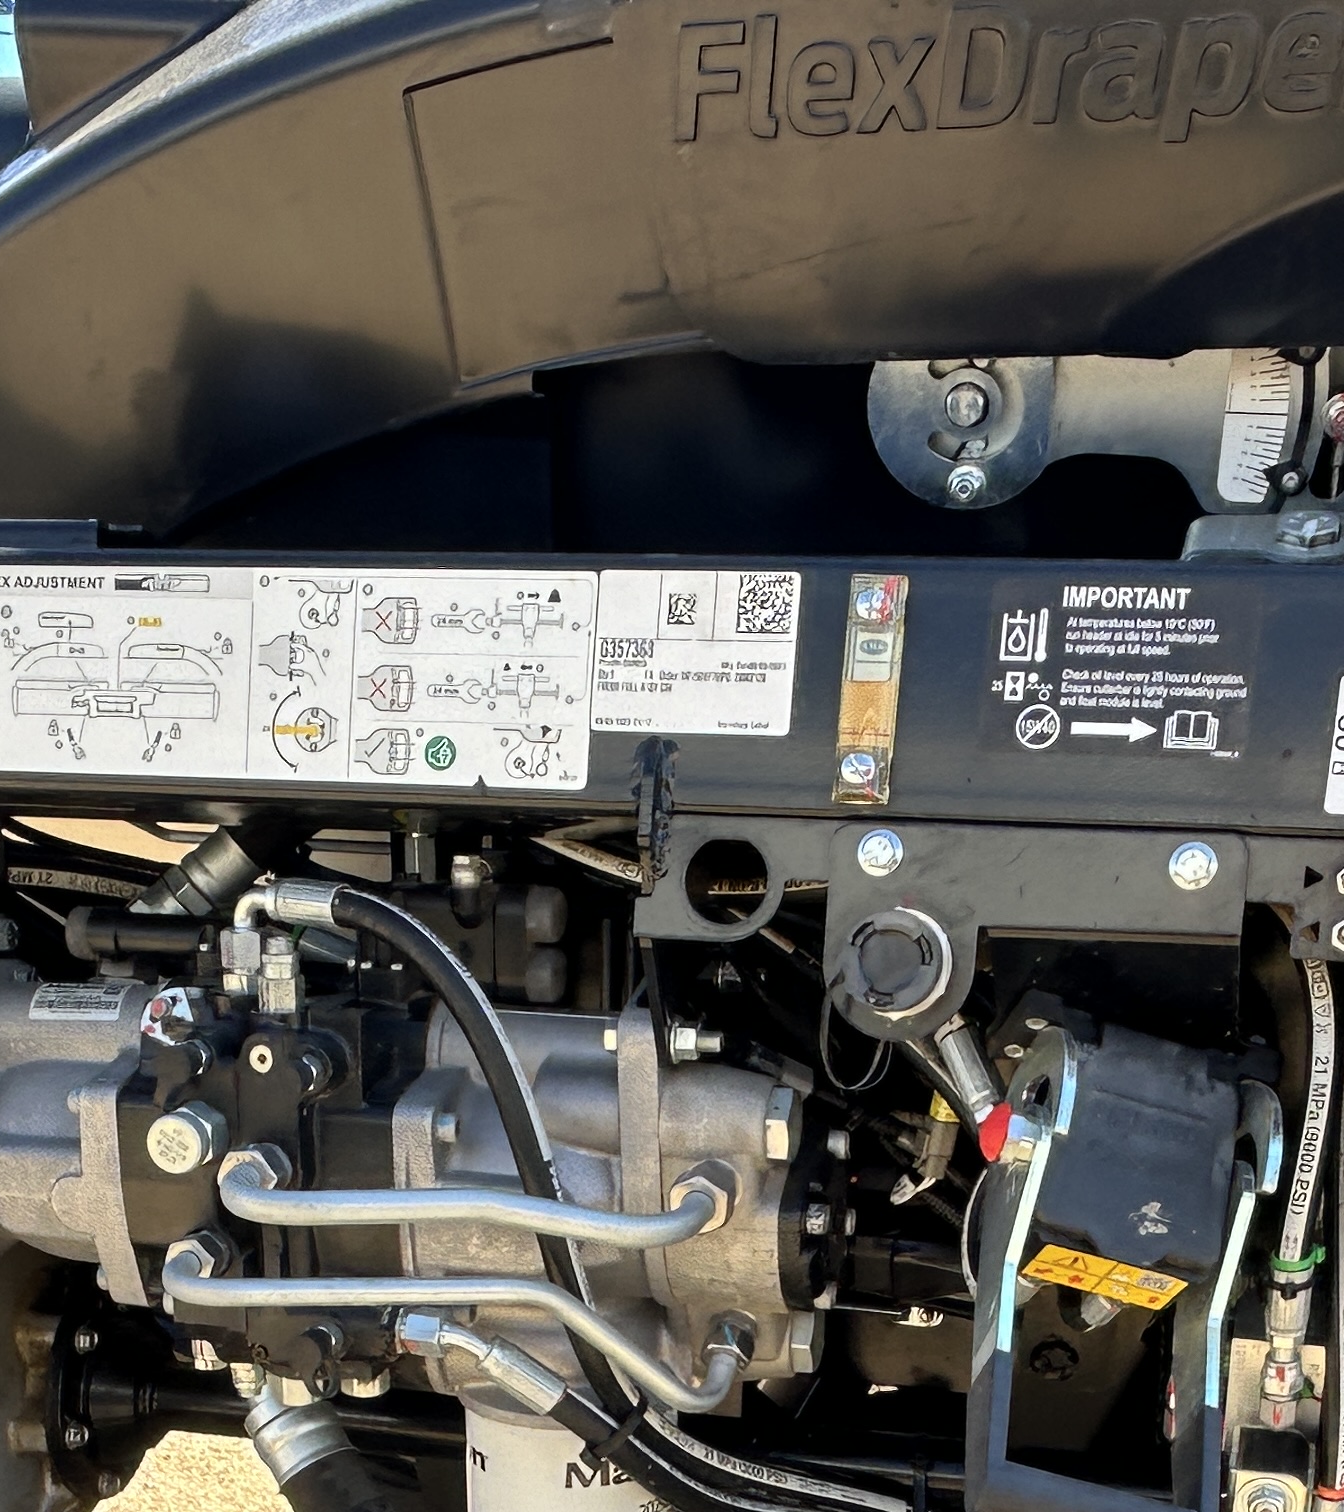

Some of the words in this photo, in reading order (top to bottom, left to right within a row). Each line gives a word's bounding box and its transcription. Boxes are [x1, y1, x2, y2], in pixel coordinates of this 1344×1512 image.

[14, 576, 105, 589] ADJUSTMENT
[1062, 585, 1192, 610] IMPORTANT
[1313, 1055, 1330, 1077] 21
[1307, 1082, 1331, 1124] MPa
